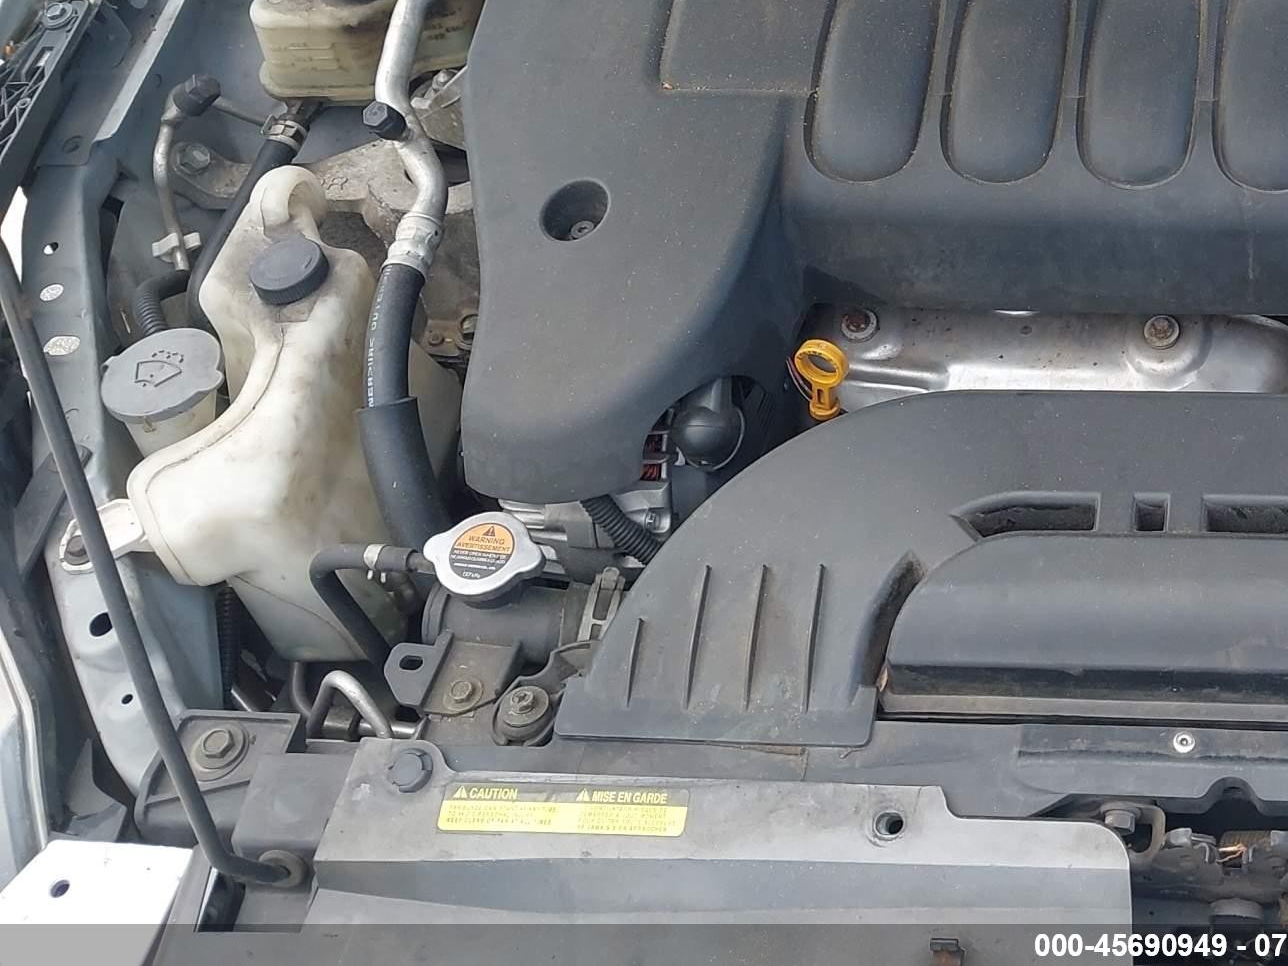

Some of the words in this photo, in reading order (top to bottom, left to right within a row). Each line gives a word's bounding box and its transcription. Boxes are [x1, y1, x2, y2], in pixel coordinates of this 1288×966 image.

[468, 535, 505, 545] WARNING
[456, 542, 511, 553] AVERTISSEMENT
[469, 787, 519, 800] CAUTION
[591, 791, 617, 802] MISE
[617, 792, 633, 803] EN
[633, 792, 668, 804] GARDE
